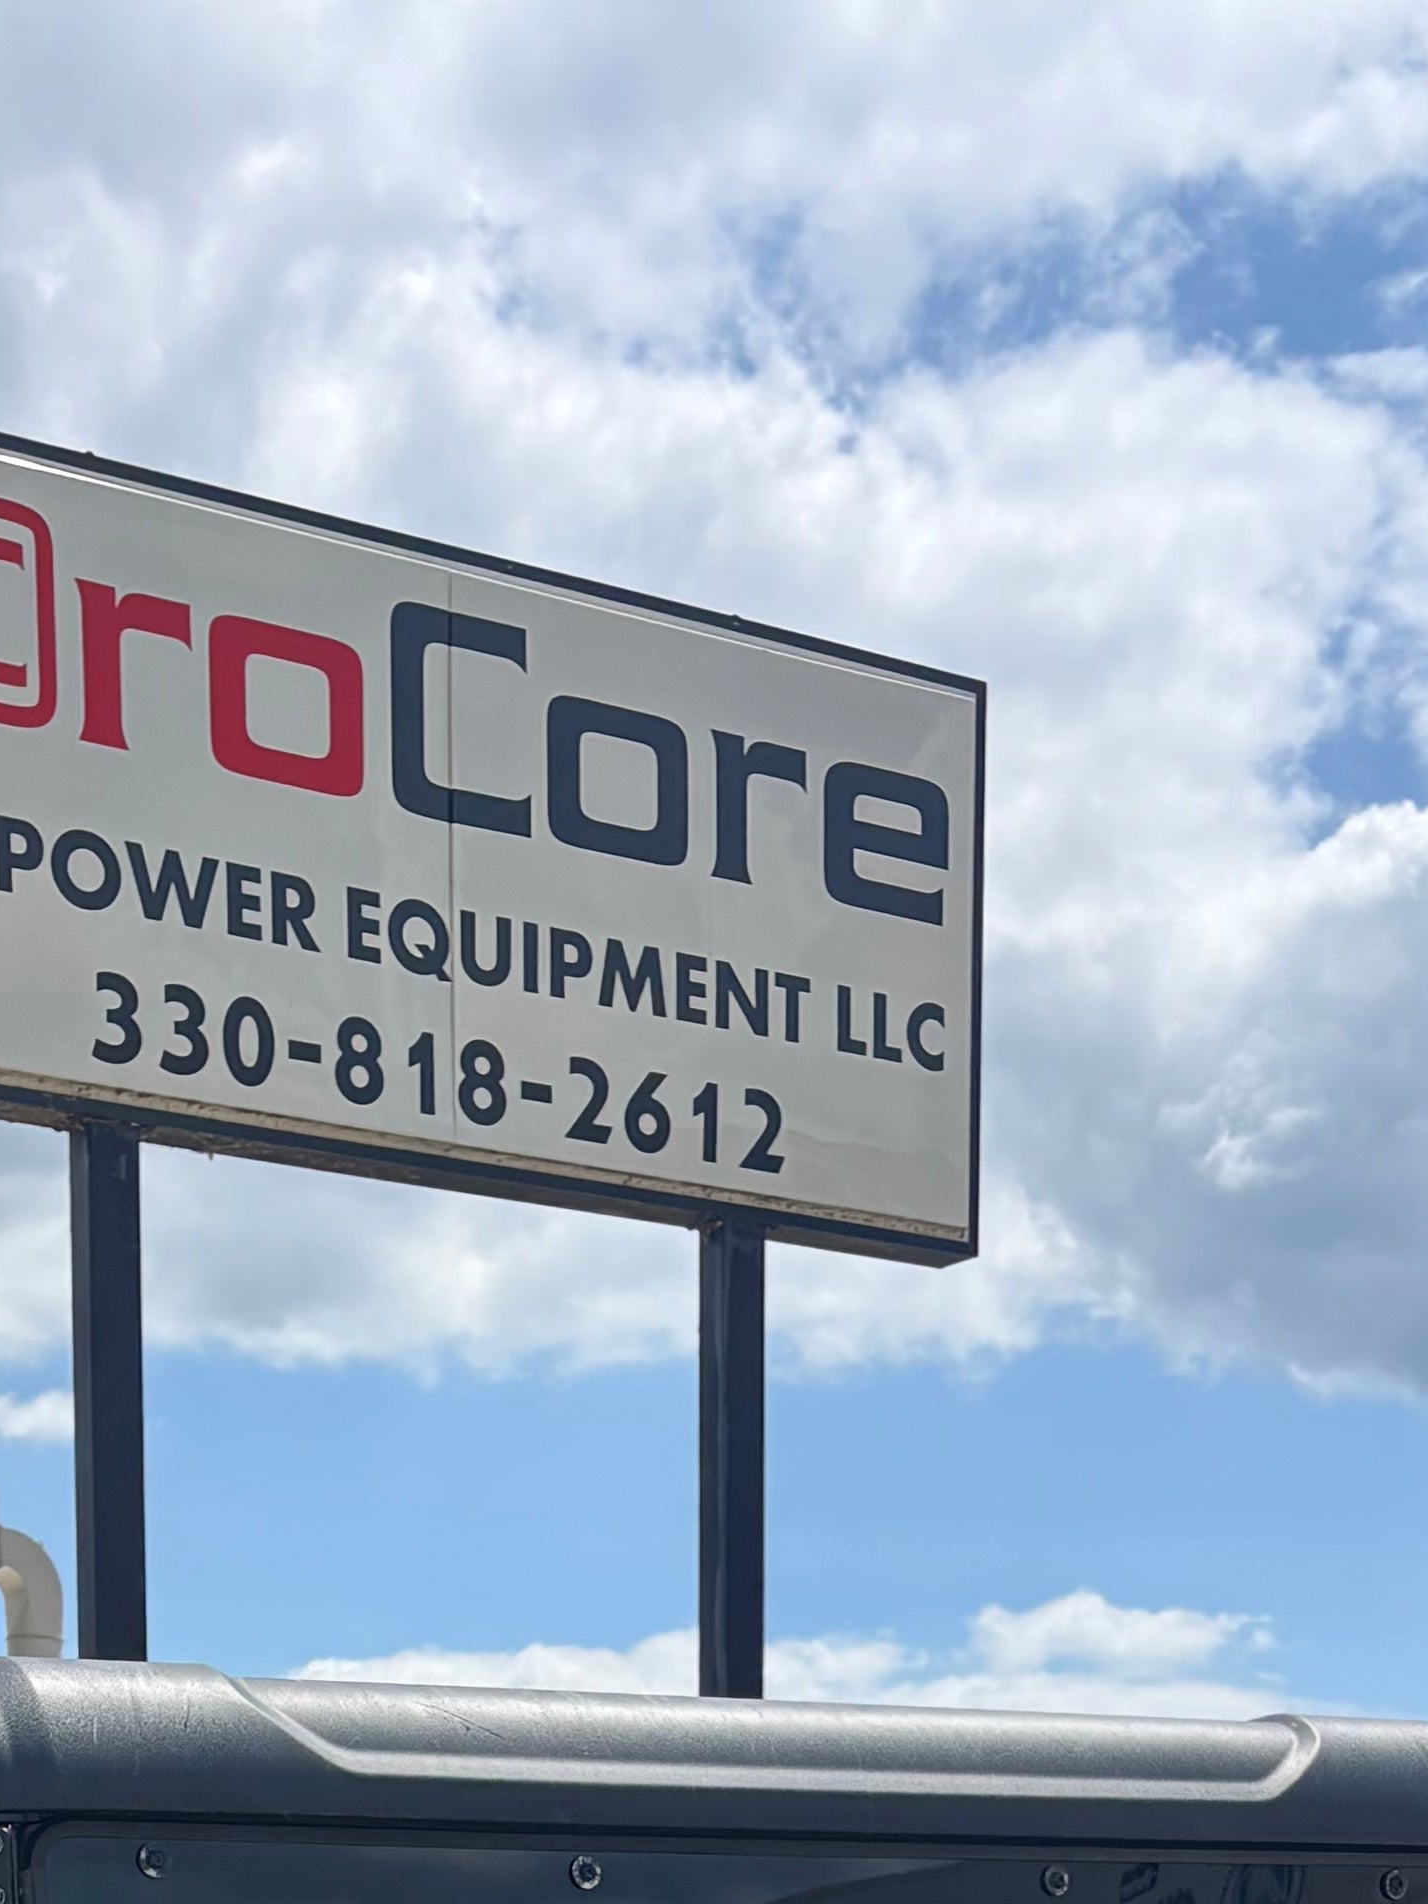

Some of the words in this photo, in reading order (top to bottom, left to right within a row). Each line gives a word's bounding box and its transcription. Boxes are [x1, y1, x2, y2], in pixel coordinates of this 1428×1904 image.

[90, 970, 786, 1175] 330-818-2612
[346, 886, 812, 1044] EQUIPMENT
[836, 984, 946, 1072] LLC
